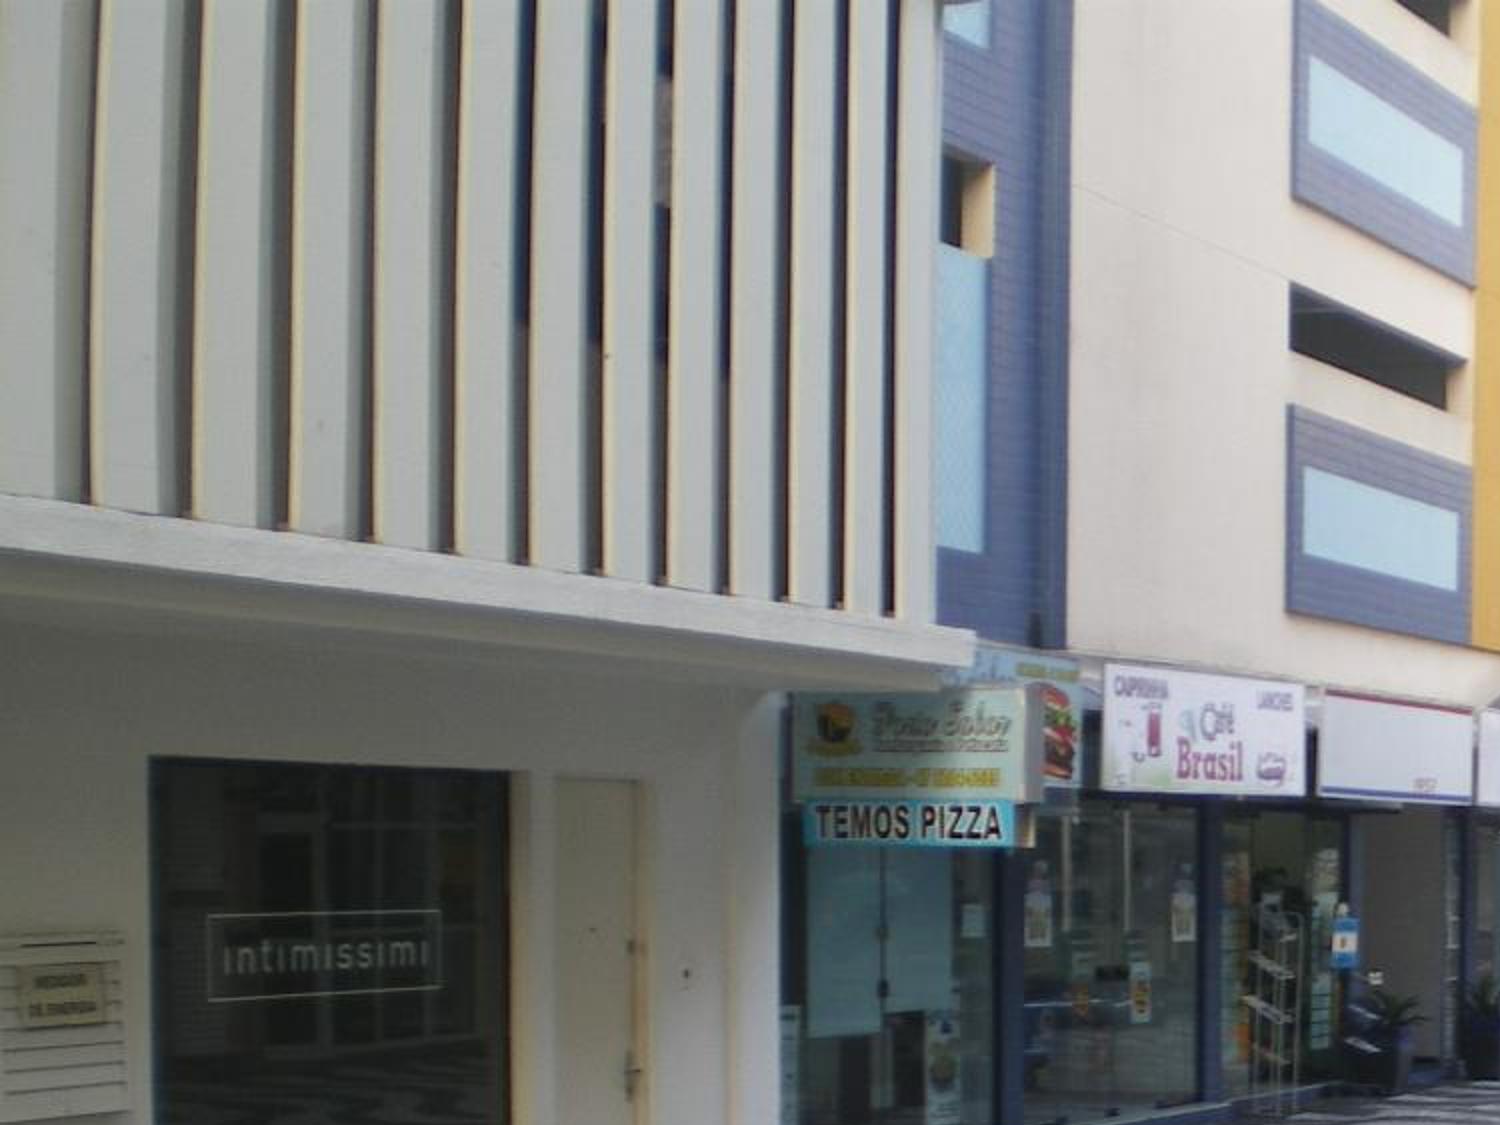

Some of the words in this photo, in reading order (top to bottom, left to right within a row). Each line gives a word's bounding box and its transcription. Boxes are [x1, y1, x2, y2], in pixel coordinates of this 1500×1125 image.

[1176, 736, 1244, 781] Brasil
[815, 805, 909, 840] TEMOS
[922, 805, 1003, 840] PIZZA
[223, 938, 432, 977] intimissimi
